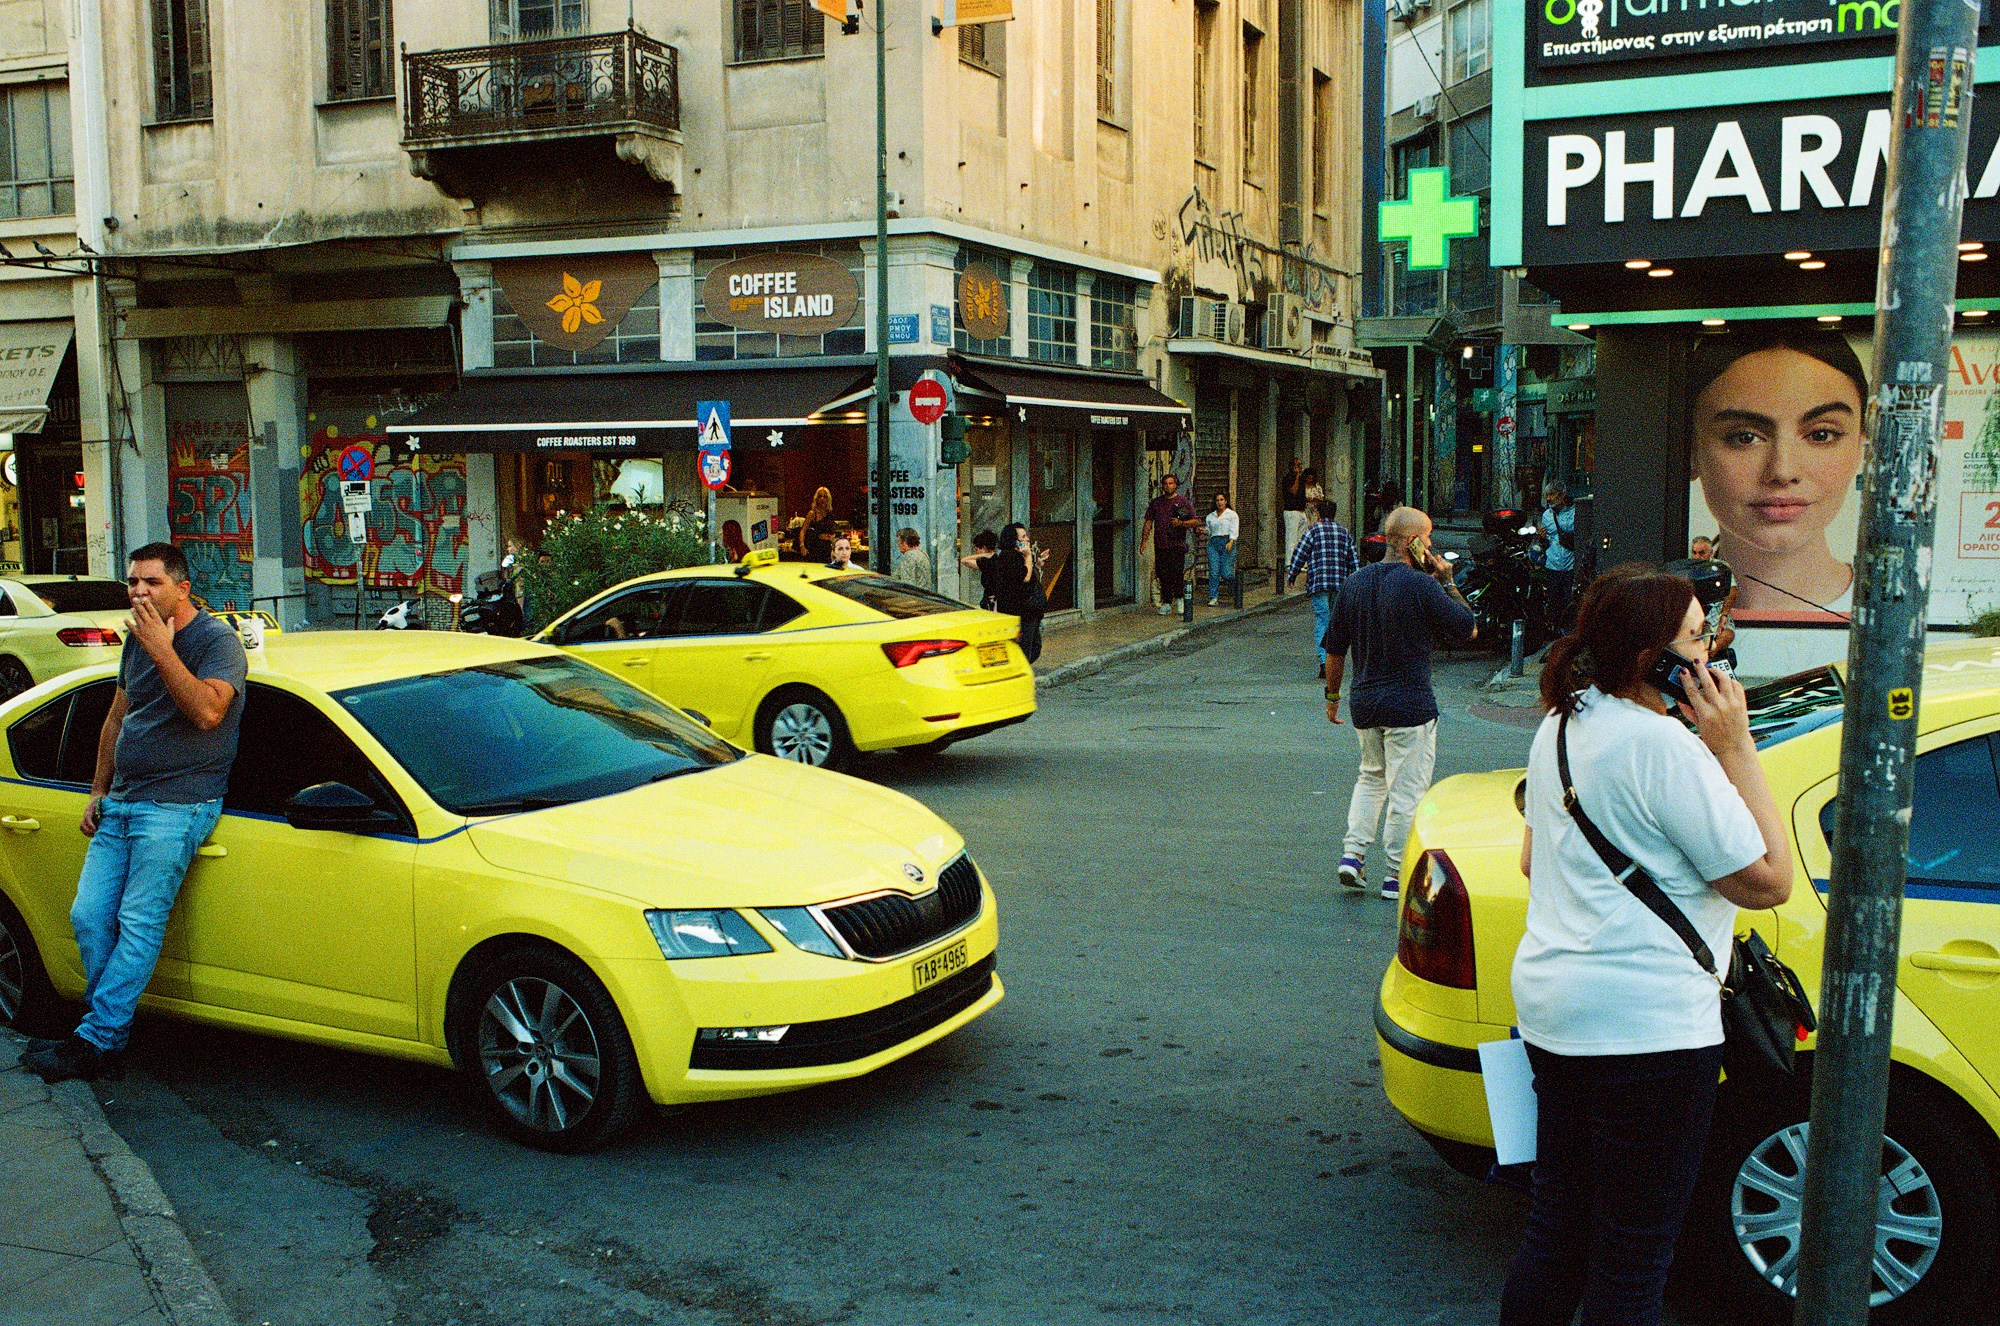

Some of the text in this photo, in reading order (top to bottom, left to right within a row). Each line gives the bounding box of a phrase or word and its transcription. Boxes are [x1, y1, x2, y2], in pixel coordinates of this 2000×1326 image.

[1543, 35, 1656, 57] Επιστήμονας
[1661, 30, 1705, 46] στην
[729, 272, 797, 296] COFFEE
[764, 294, 834, 318] ISLAND
[537, 436, 636, 447] COFFEE ROASTERS EST 1999
[871, 470, 909, 482] CFEE
[871, 486, 925, 499] RSTERS
[892, 503, 918, 515] 1999
